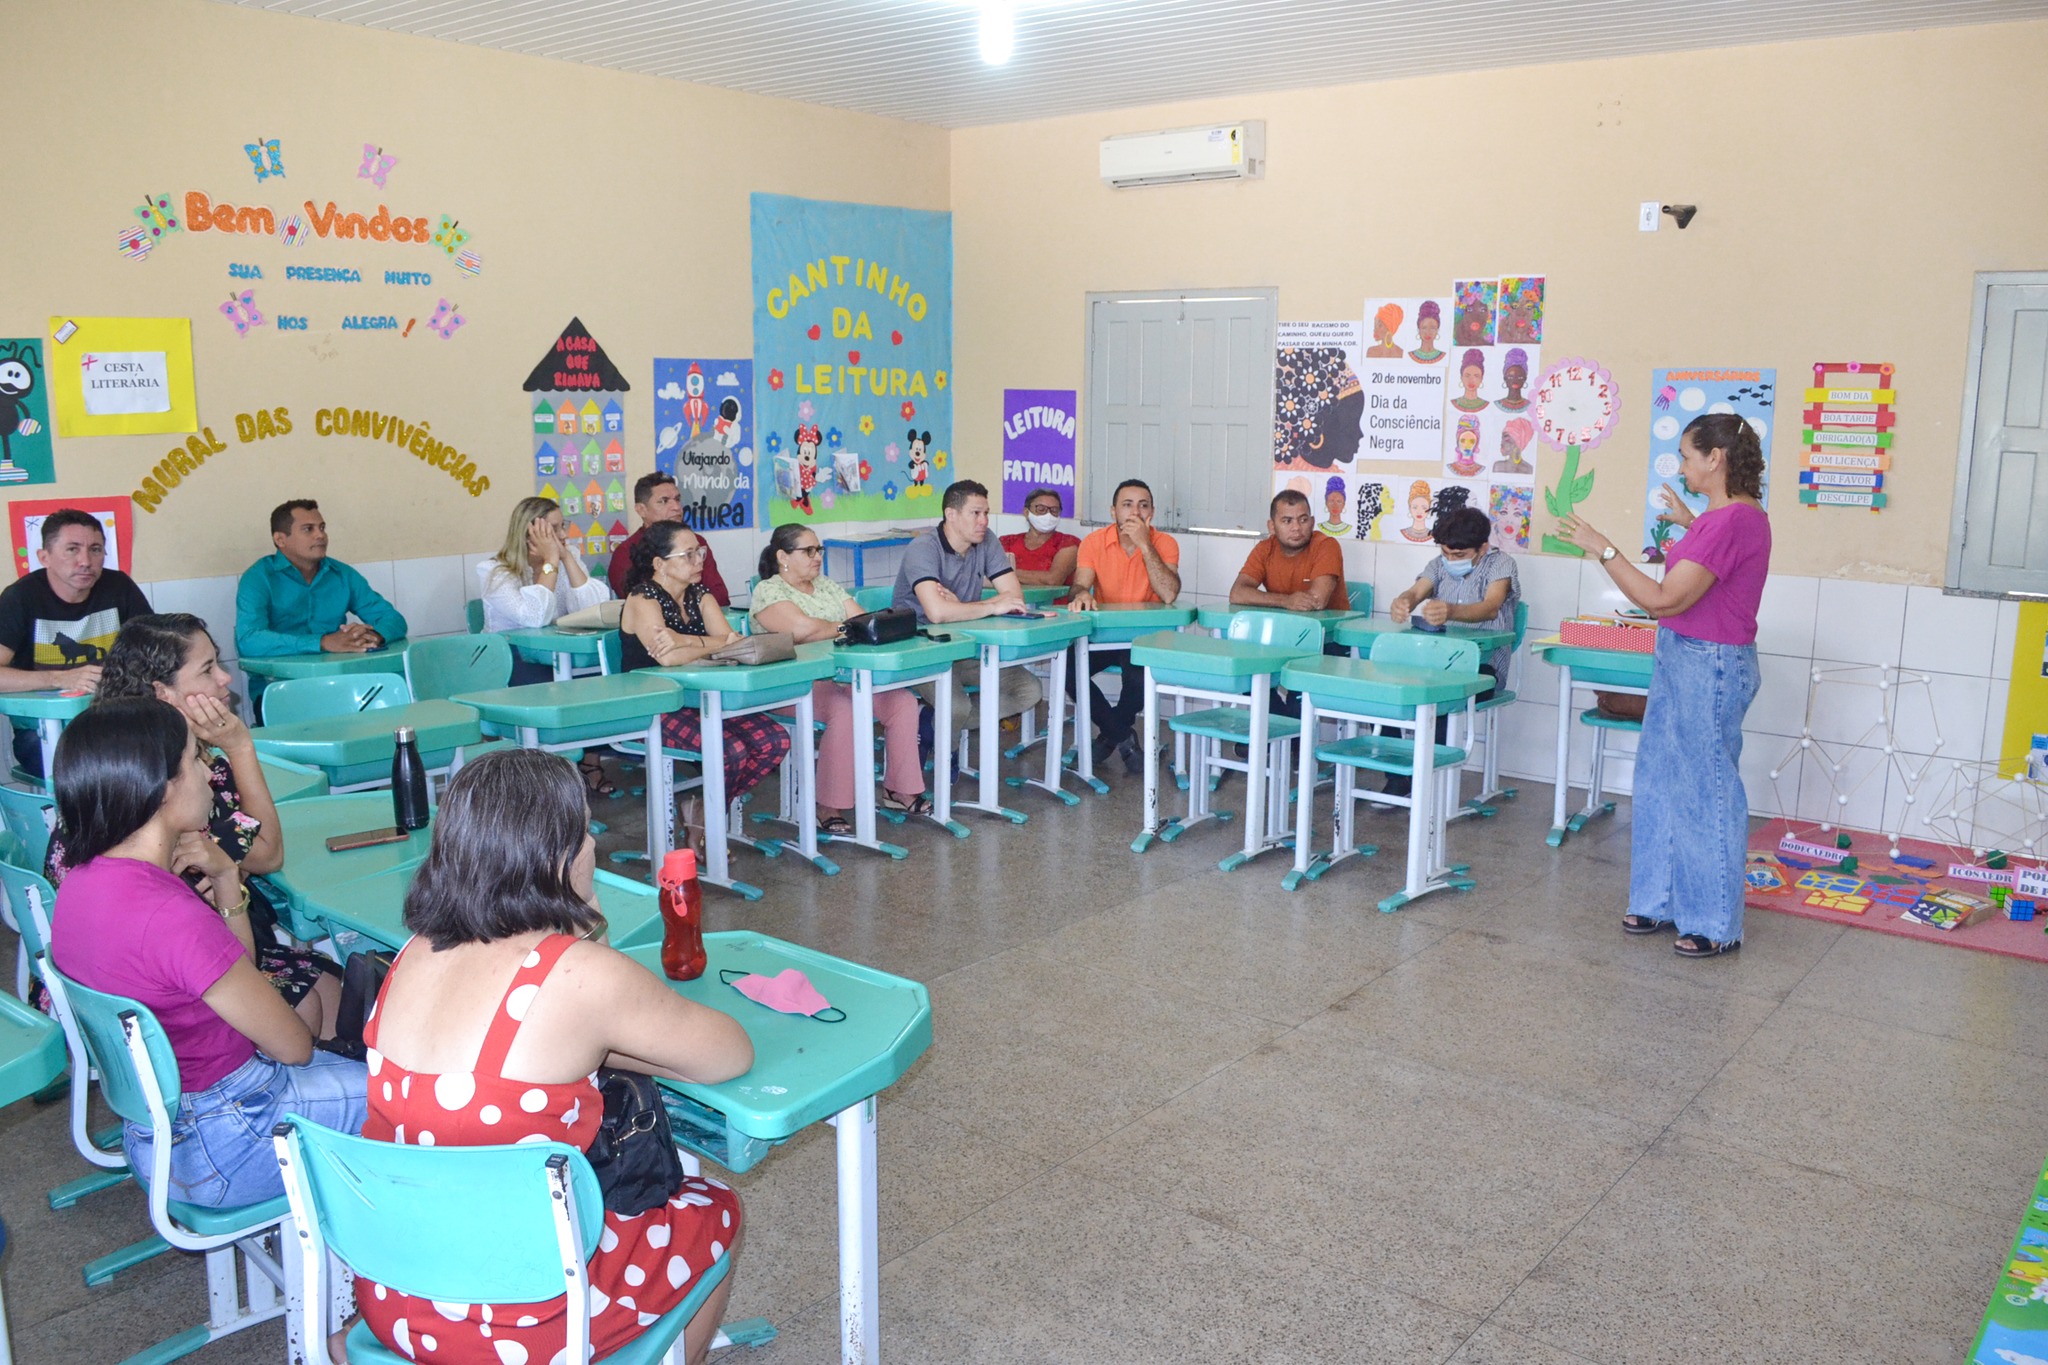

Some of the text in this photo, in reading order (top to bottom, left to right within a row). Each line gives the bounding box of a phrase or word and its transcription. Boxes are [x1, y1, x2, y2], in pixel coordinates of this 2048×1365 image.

[184, 191, 430, 243] Bem Vindos
[228, 263, 431, 287] SUA PRESENÇA MUITO
[767, 255, 928, 322] CANTINHO
[278, 315, 308, 330] NOS
[832, 307, 873, 340] DA
[556, 336, 597, 352] A CASA
[104, 362, 144, 373] CESTA
[566, 354, 589, 370] QUE
[91, 373, 160, 389] LITERÁRIA
[554, 372, 601, 388] RIMAVA
[796, 363, 928, 398] LEITURA
[1372, 372, 1441, 384] 20 de novembro
[1549, 373, 1562, 388] 11
[1567, 367, 1582, 380] 12
[1588, 371, 1595, 386] 1
[1539, 388, 1553, 403] 10
[1598, 384, 1608, 398] 2
[1830, 391, 1869, 400] BOM DIA
[1371, 394, 1407, 409] Dia da
[1602, 401, 1612, 416] 3
[1004, 406, 1075, 440] LEITURA
[1370, 414, 1441, 430] Consciência
[1594, 417, 1604, 431] 4
[1823, 413, 1875, 423] BOA TARDE
[1543, 419, 1552, 433] 8
[1556, 428, 1565, 442] 7
[1567, 431, 1576, 445] 6
[1815, 433, 1876, 444] OBRIGADO(A)
[1369, 435, 1404, 453] Negra
[131, 407, 490, 514] MURAL DAS CONVIVÊNCIAS
[1811, 455, 1877, 468] COM LICENÇA
[733, 472, 750, 489] da
[1003, 460, 1074, 487] FATIADA
[1817, 475, 1872, 485] POR FAVOR
[1819, 493, 1870, 504] DESCULPE
[1952, 868, 2013, 883] ICOSAEDR
[2020, 884, 2039, 894] DE
